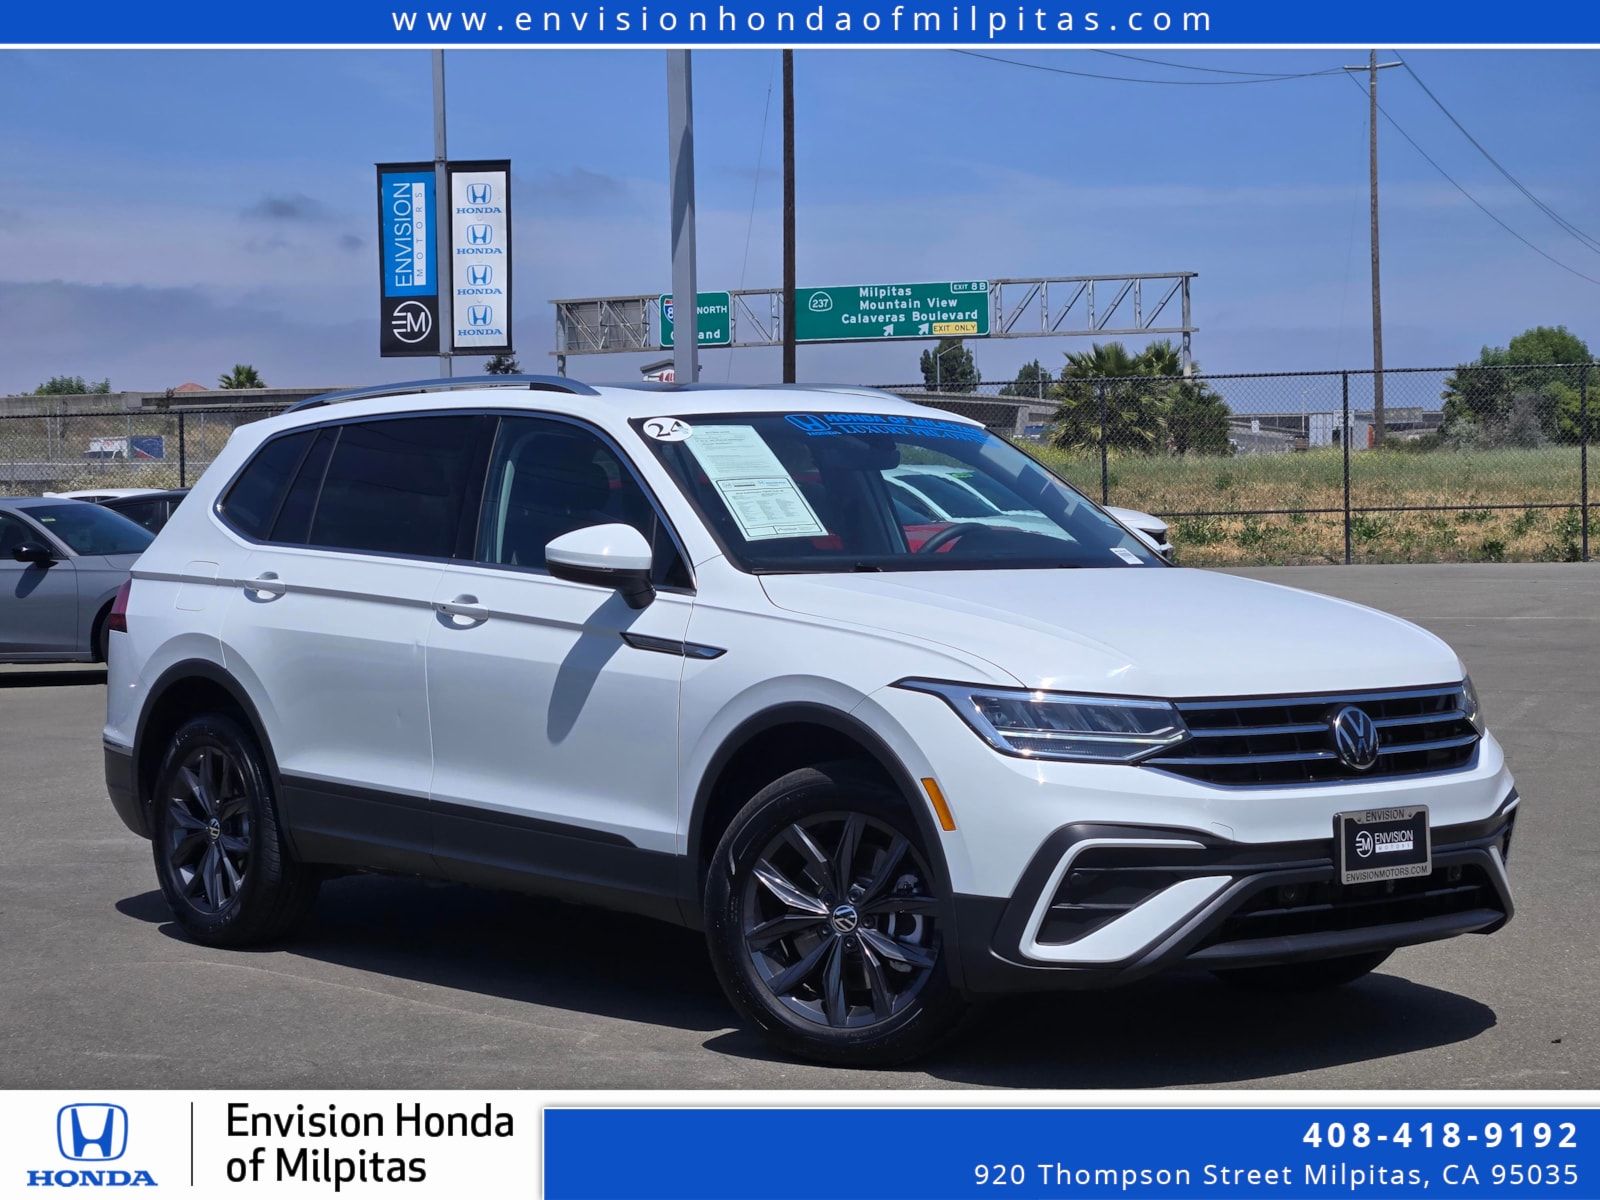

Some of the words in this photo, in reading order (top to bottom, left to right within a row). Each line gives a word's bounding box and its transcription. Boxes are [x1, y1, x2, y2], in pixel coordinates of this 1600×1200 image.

[393, 182, 413, 287] ENVISION
[415, 192, 423, 277] MOTORS
[860, 287, 912, 299] Milpitas
[697, 305, 728, 315] NORTH
[812, 299, 829, 308] 237
[860, 299, 921, 311] Mountain
[927, 298, 958, 308] View
[842, 312, 906, 324] Calaveras
[912, 310, 978, 321] Boulevard
[954, 324, 976, 332] ONLY
[824, 414, 887, 423] HONDA
[1366, 809, 1405, 822] ENVISION
[1374, 830, 1413, 844] ENVISION
[1346, 865, 1428, 882] ENVISIONMOTORS.COM
